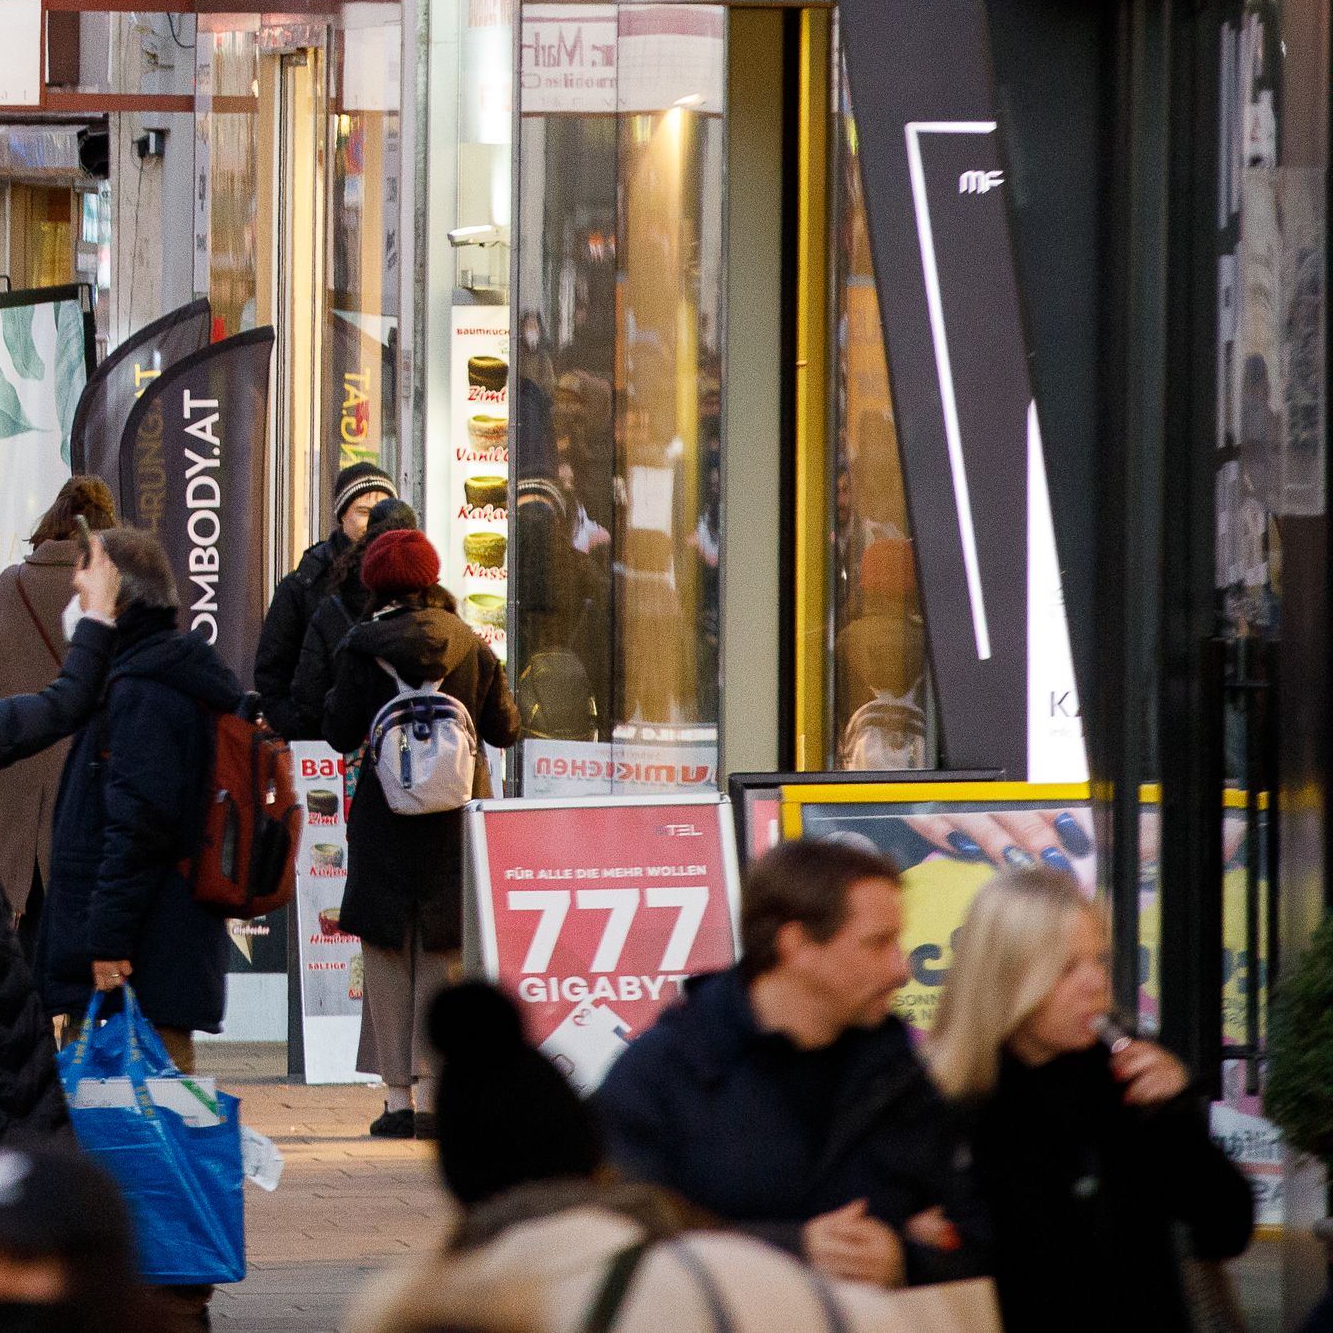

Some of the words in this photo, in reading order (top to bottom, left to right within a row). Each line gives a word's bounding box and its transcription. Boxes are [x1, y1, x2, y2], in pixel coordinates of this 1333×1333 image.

[505, 866, 534, 881] FÜR
[537, 867, 573, 880] ALLE
[575, 868, 600, 879] DIE
[602, 867, 644, 878] MEHR
[646, 865, 707, 877] WOLLEN
[507, 886, 710, 974] 777
